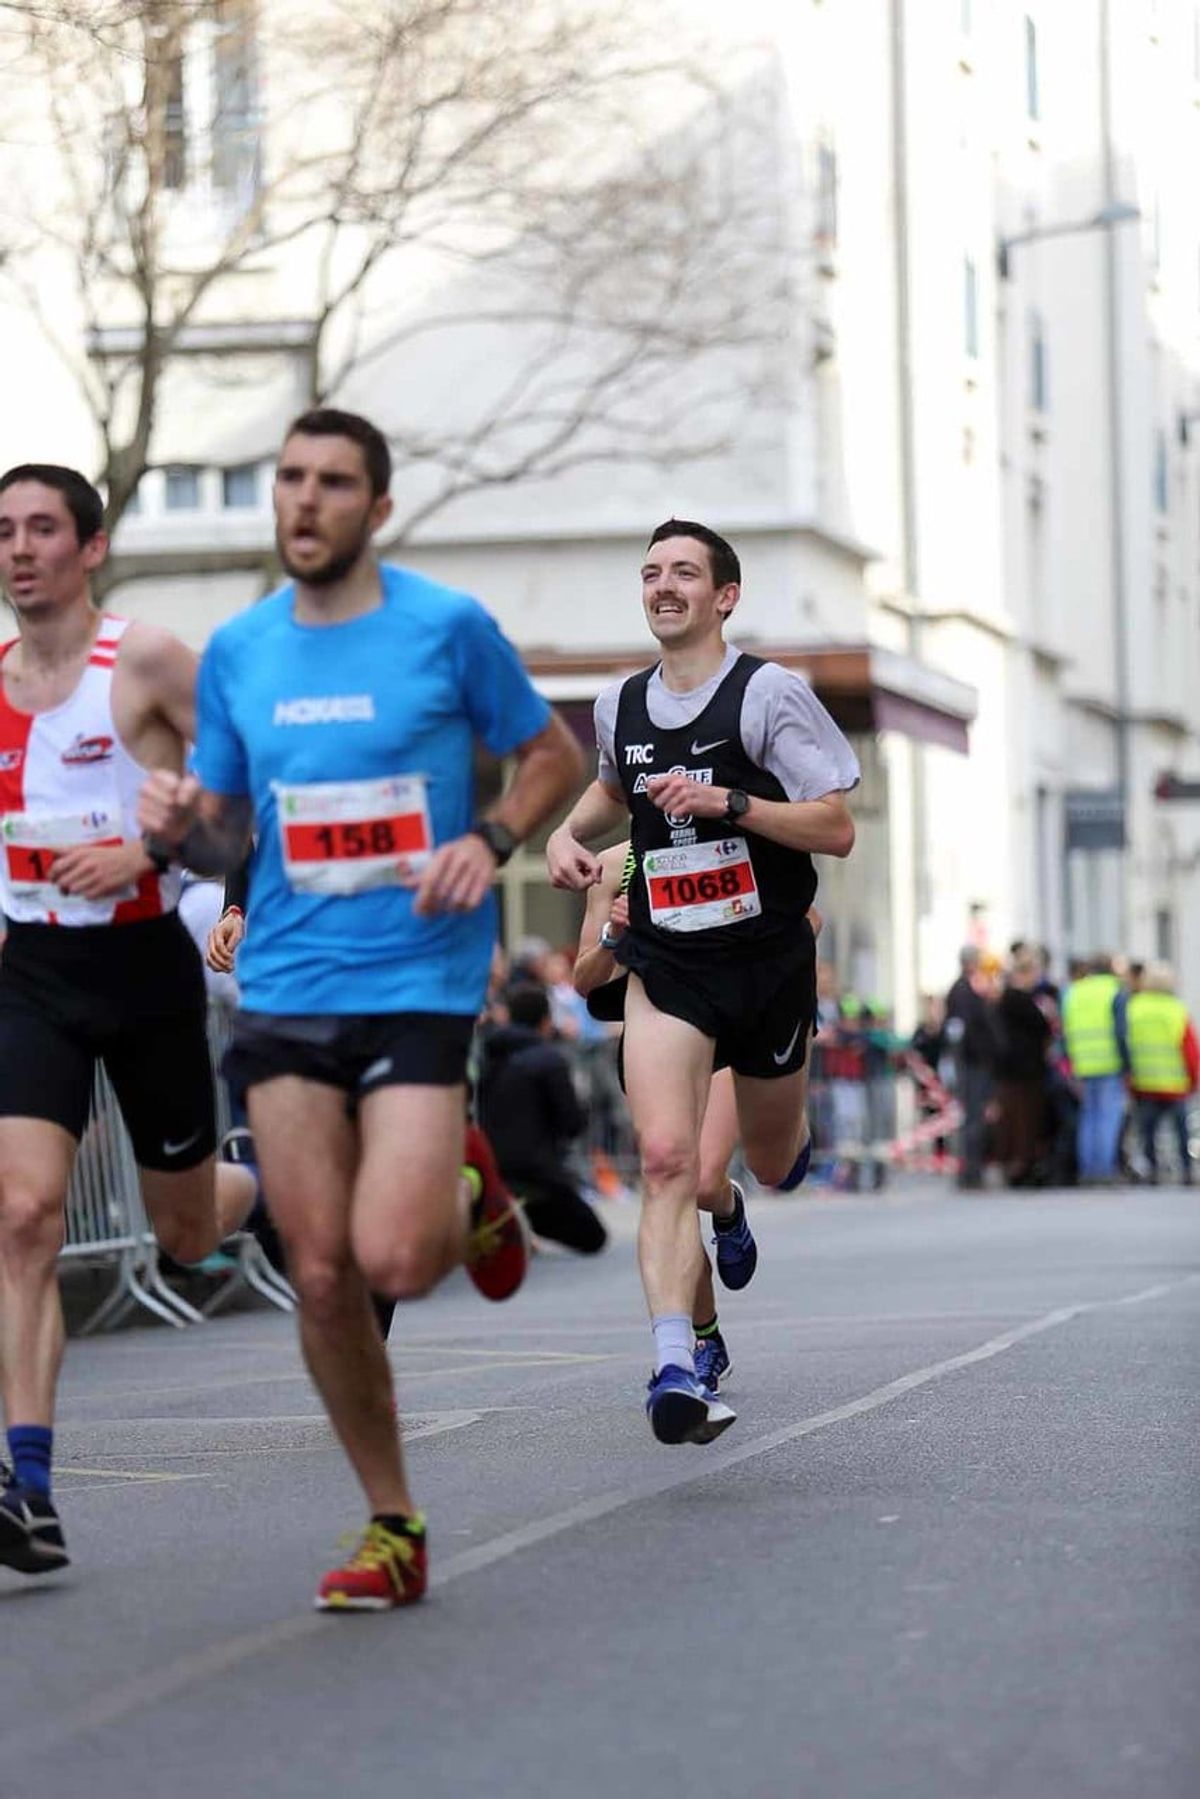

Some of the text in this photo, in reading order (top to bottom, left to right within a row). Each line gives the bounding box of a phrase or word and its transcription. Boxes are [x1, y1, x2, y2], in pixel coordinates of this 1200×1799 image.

[625, 744, 654, 765] TRC
[317, 822, 396, 857] 158
[662, 869, 741, 905] 1068
